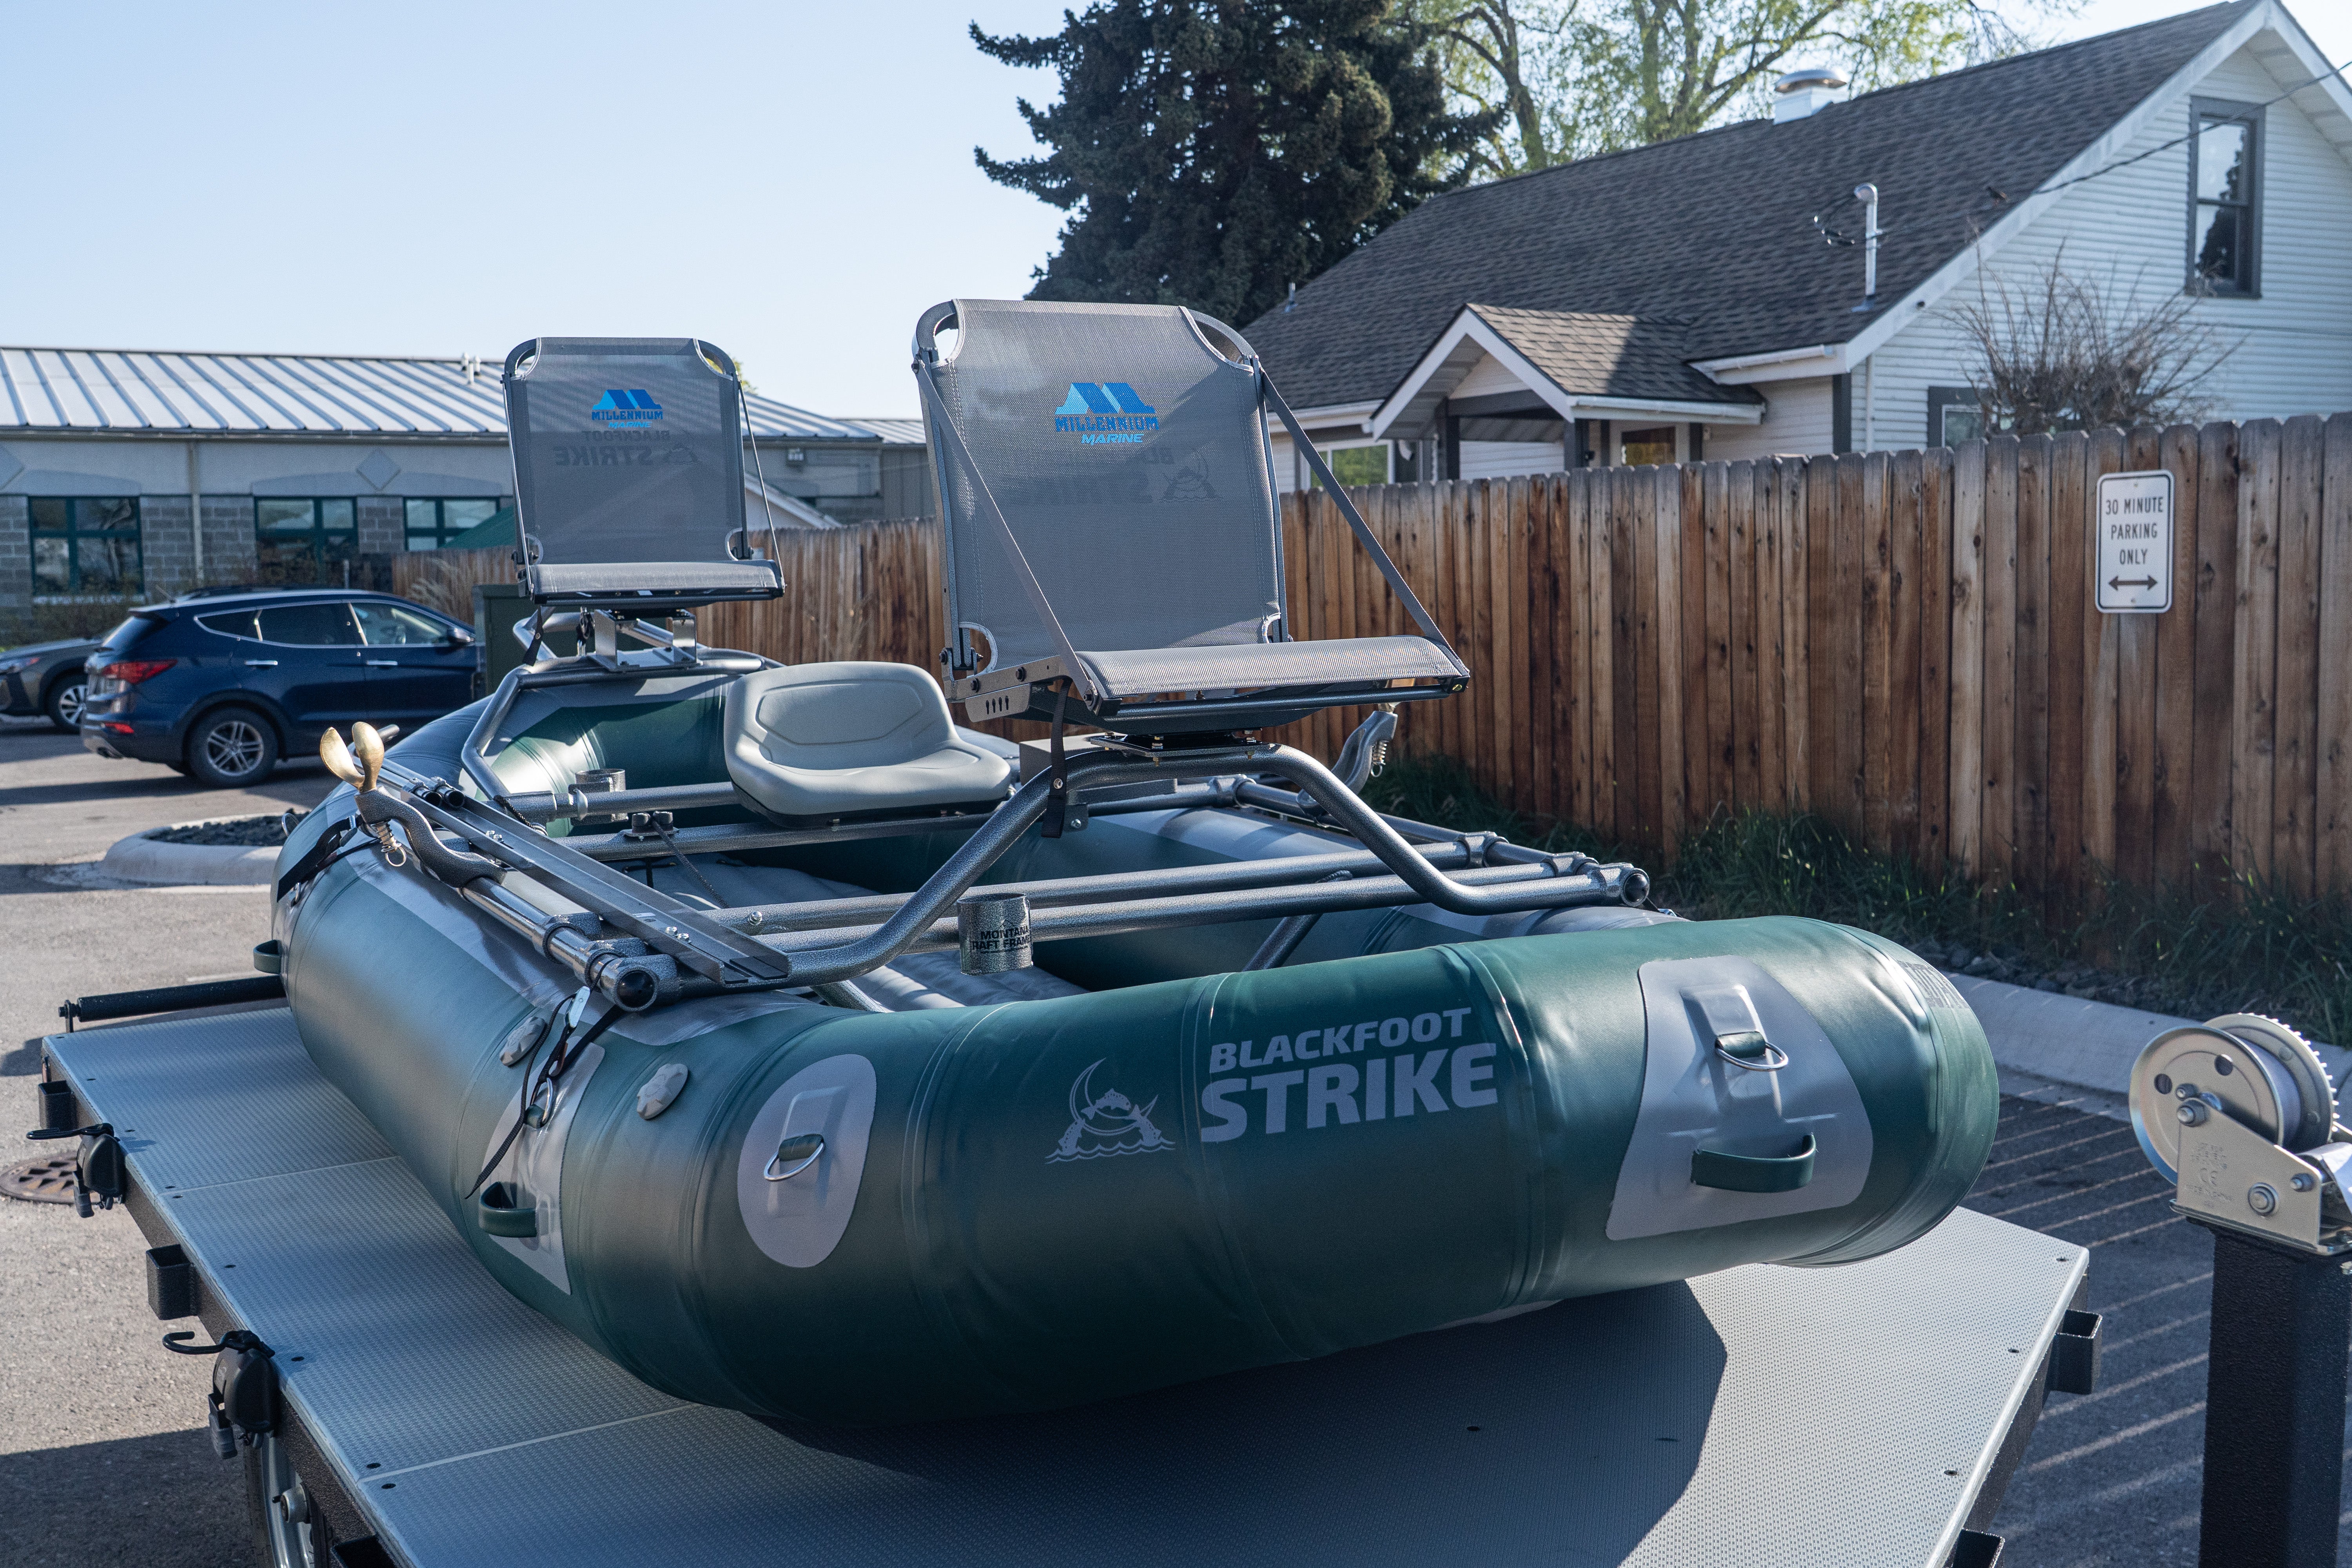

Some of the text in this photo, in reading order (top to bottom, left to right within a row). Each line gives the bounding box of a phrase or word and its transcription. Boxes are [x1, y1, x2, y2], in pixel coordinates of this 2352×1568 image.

[592, 410, 663, 420] MILLENNIUM
[1055, 417, 1159, 432] MILLENNIUM
[1081, 434, 1144, 445] MARINE
[2106, 496, 2163, 515] 30 MINUTE
[2111, 522, 2158, 540] PARKING
[2120, 549, 2148, 564] ONLY
[981, 926, 1029, 940] MONTANA
[972, 940, 1000, 950] RAFT
[1209, 1007, 1472, 1073] BLACKFOOT
[1201, 1042, 1499, 1143] STRIKE
